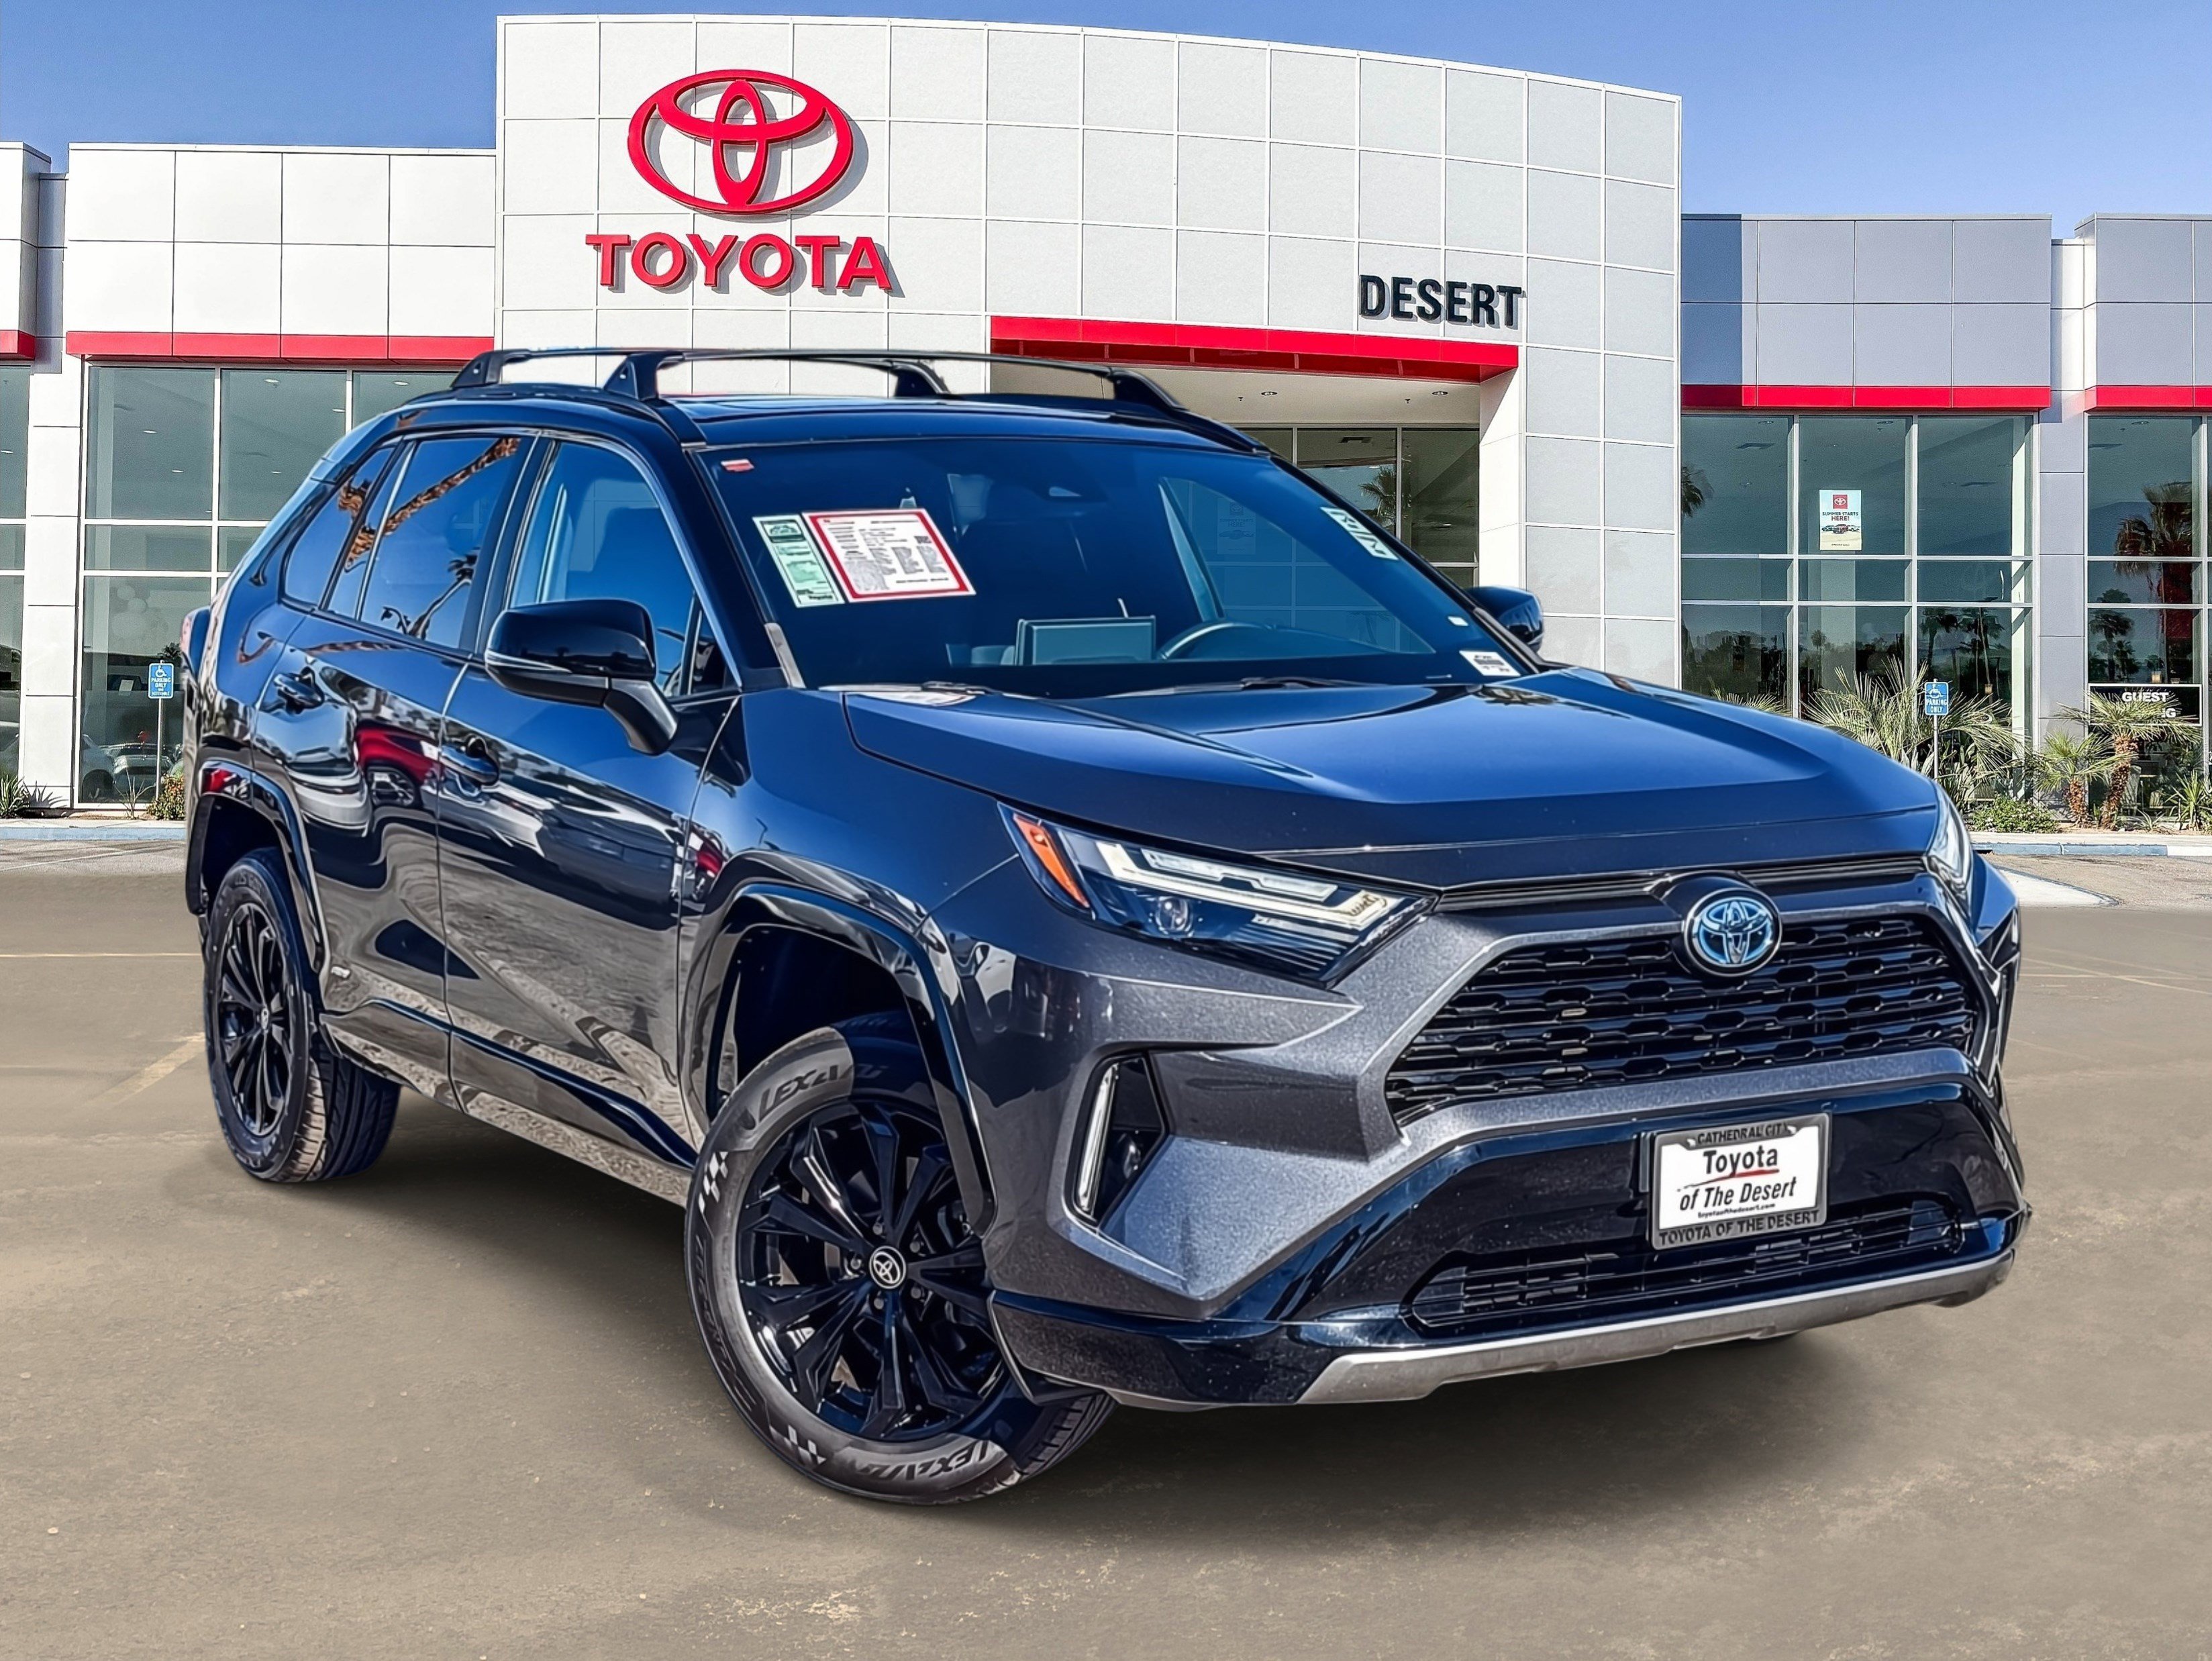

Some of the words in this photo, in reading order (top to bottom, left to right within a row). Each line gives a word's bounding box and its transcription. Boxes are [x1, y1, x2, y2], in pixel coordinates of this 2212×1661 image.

[585, 232, 893, 290] TOYOTA
[1359, 274, 1522, 328] DESERT
[2122, 691, 2169, 703] GUEST
[1697, 1125, 1762, 1144] CATHEDRAL
[1703, 1144, 1778, 1177] Toyota
[1679, 1189, 1700, 1211] of
[1704, 1186, 1734, 1208] The
[1740, 1176, 1797, 1204] Desert
[1659, 1225, 1711, 1246] TOYOTA
[1716, 1221, 1733, 1236] OF
[1738, 1217, 1764, 1233] THE
[1768, 1209, 1819, 1229] DESERT
